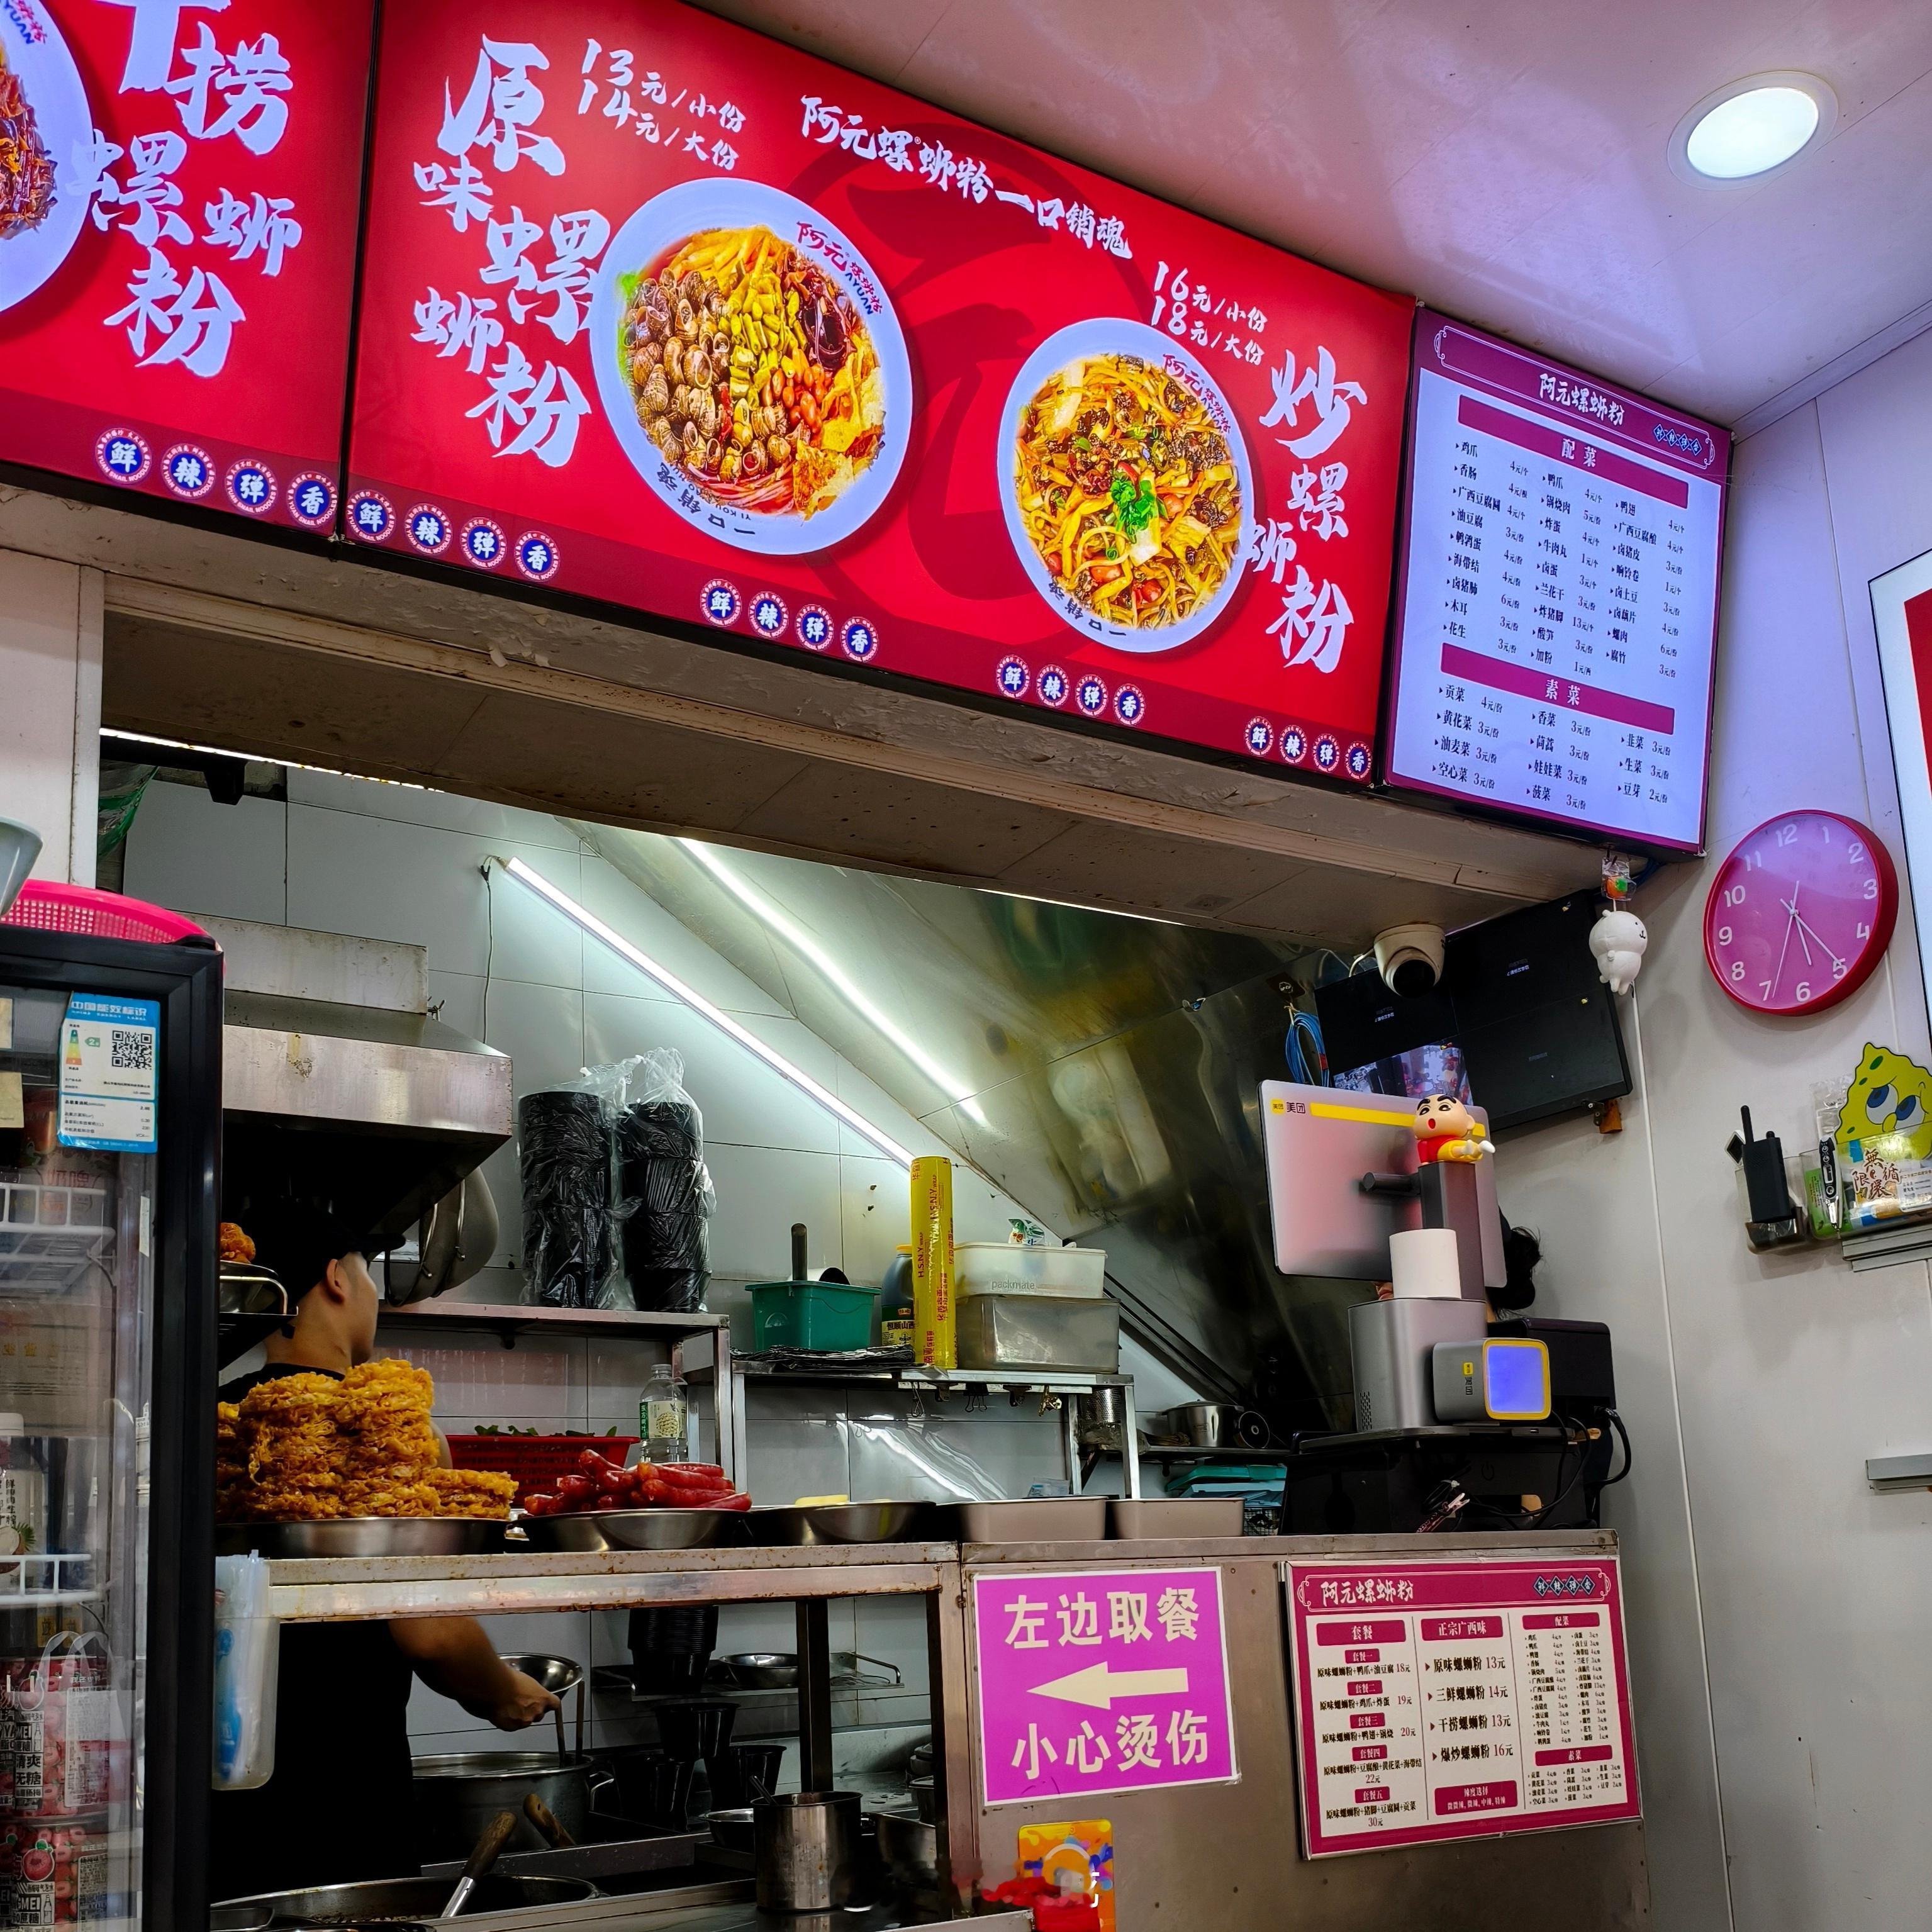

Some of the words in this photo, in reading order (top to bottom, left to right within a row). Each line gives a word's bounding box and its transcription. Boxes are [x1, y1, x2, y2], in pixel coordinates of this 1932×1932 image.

[581, 38, 746, 133] 13元/小份
[578, 79, 739, 170] 14元/大份
[412, 33, 610, 467] 原味螺蛳粉
[845, 272, 873, 315] AYUAN
[1154, 260, 1268, 332] 16元/小份
[1151, 295, 1265, 366] 18元/大份
[1539, 373, 1625, 426] 阿元螺蛳粉
[109, 441, 137, 472] 鲜
[1461, 442, 1478, 457] 鸡爪
[1561, 438, 1597, 467] 配菜
[129, 461, 150, 481] NOODLES
[174, 457, 202, 488] 辣
[1460, 464, 1477, 480] 香肠
[240, 474, 264, 503] 弹
[1548, 473, 1563, 489] 鸭爪
[301, 486, 324, 515] 香
[1238, 346, 1368, 673] 炒螺蛳粉
[1546, 494, 1570, 515] 锅烧肉
[1620, 501, 1636, 516] 鸭翅
[359, 502, 383, 532] 鲜
[1457, 508, 1483, 528] 油豆腐
[1545, 517, 1561, 533] 炸蛋
[415, 517, 441, 545] 辣
[474, 532, 494, 558] 弹
[1543, 539, 1567, 557] 牛肉丸
[1617, 543, 1640, 561] 卤猪皮
[527, 545, 547, 571] 香
[1454, 552, 1479, 573] 海带结
[1542, 561, 1558, 578] 卤蛋
[1540, 582, 1564, 601] 兰花干
[1615, 586, 1638, 603] 卤土豆
[710, 591, 731, 618] 鲜
[1451, 599, 1467, 616] 木耳
[1539, 605, 1563, 623] 炸猪脚
[757, 603, 779, 630] 辣
[807, 617, 824, 642] 弹
[1449, 621, 1466, 639] 花生
[1537, 627, 1554, 641] 酸笋
[1612, 627, 1628, 643] 螺肉
[851, 629, 868, 653] 香
[1535, 649, 1552, 665] 加粉
[1611, 649, 1626, 664] 腐竹
[1005, 666, 1022, 691] 鲜
[1043, 676, 1061, 700] 辣
[1085, 686, 1099, 708] 弹
[1446, 684, 1465, 702] 贡菜
[1545, 679, 1581, 706] 素菜
[1122, 695, 1136, 717] 香
[1443, 710, 1472, 730] 黄花菜
[1538, 711, 1556, 727] 香菜
[1251, 726, 1266, 749] 鲜
[1285, 735, 1300, 757] 辣
[1441, 735, 1470, 756] 油麦菜
[1536, 735, 1554, 752] 茼蒿
[1627, 734, 1644, 750] 韭菜
[1320, 744, 1333, 764] 弹
[1352, 751, 1365, 772] 香
[1438, 762, 1467, 783] 空心菜
[1534, 760, 1562, 779] 娃娃菜
[1625, 757, 1643, 774] 生菜
[1533, 785, 1551, 801] 菠菜
[1623, 782, 1641, 798] 豆芽
[1776, 823, 1798, 847] 12
[1823, 825, 1830, 844] 1
[1745, 850, 1762, 871] 11
[1849, 841, 1864, 863] 2
[1724, 885, 1746, 907] 10
[1863, 879, 1878, 900] 3
[1719, 926, 1732, 945] 9
[1857, 922, 1870, 941] 4
[1732, 961, 1745, 980] 8
[1833, 958, 1848, 979] 5
[1760, 979, 1772, 1001] 7
[1796, 982, 1811, 1003] 6
[1286, 1102, 1305, 1114] 美团
[992, 1279, 1035, 1290] packmate
[1321, 1578, 1414, 1607] 阿元螺蛳粉
[1004, 1588, 1200, 1649] 左边取餐
[1351, 1625, 1373, 1640] 套餐
[1438, 1621, 1486, 1636] 正宗广西味
[1353, 1651, 1373, 1662] 套餐一
[1485, 1656, 1505, 1670] 13元
[1396, 1663, 1410, 1673] 18元
[1355, 1684, 1376, 1694] 套餐二
[1488, 1685, 1508, 1699] 14元
[1398, 1695, 1412, 1705] 19元
[1358, 1716, 1378, 1726] 套餐三
[1492, 1714, 1511, 1728] 13元
[1401, 1728, 1416, 1736] 20元
[1012, 1710, 1209, 1780] 小心烫伤
[1360, 1748, 1380, 1758] 套餐四
[1494, 1744, 1513, 1756] 16元
[16, 1772, 42, 1785] 无糖
[1365, 1774, 1380, 1784] 22元
[1363, 1790, 1383, 1801] 套餐五
[1368, 1817, 1383, 1827] 30元
